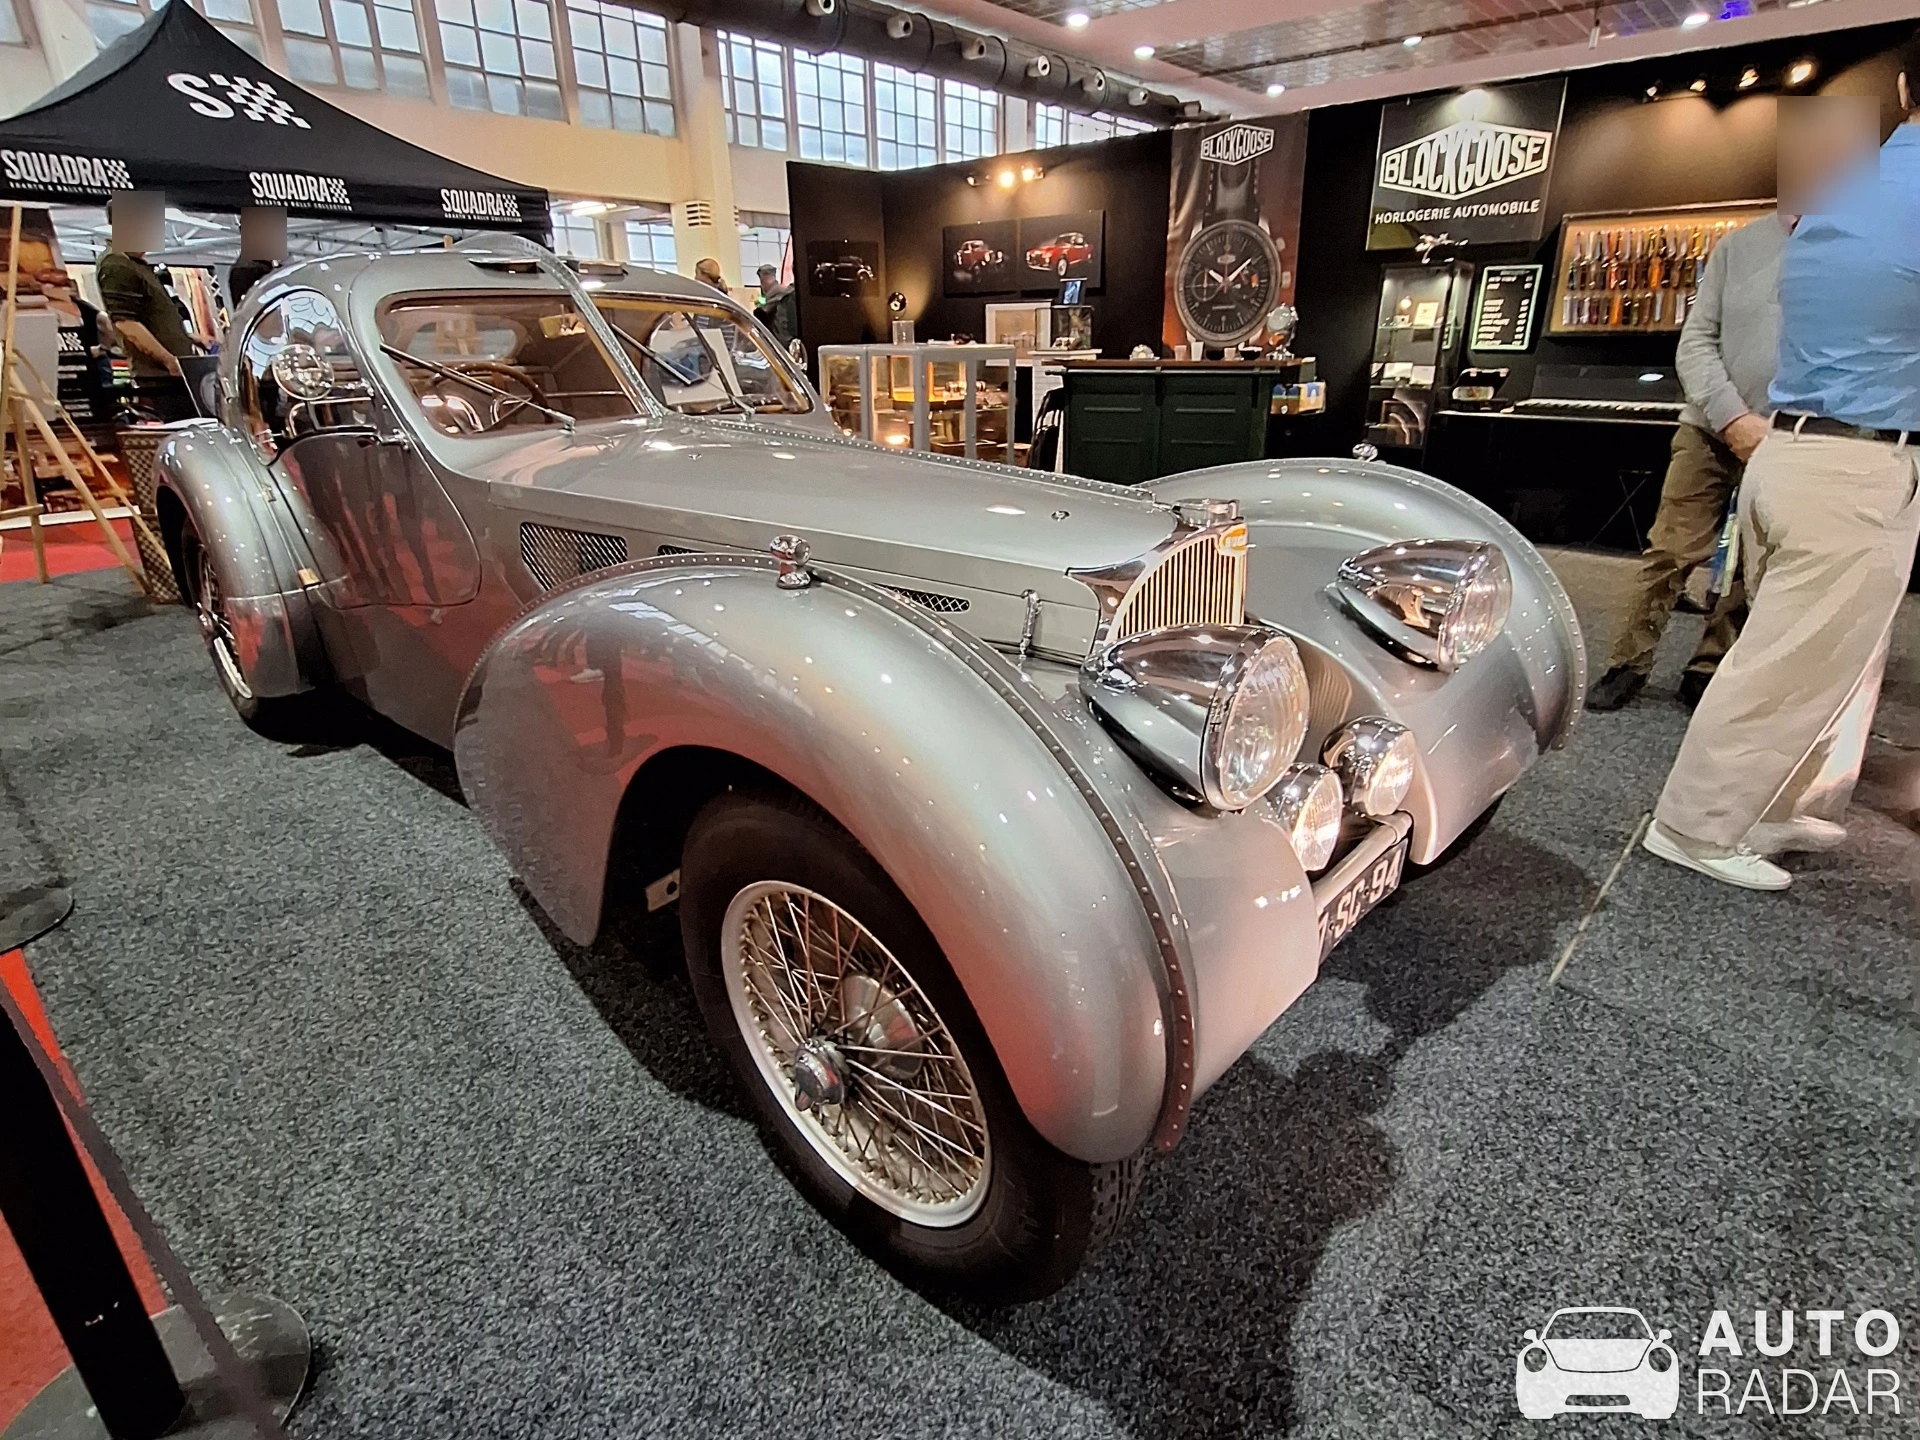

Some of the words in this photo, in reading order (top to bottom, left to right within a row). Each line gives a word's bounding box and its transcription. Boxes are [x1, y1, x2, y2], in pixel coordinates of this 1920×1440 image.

[1203, 128, 1271, 162] BLACKGOOSE
[1384, 126, 1546, 195] BLACKGOOSE
[0, 149, 111, 188] SQUADRA
[249, 171, 332, 203] SQUADRA
[440, 188, 506, 217] SQUADRA
[1374, 209, 1452, 224] HORLOGERIE
[1452, 199, 1540, 219] AUTOMOBILE
